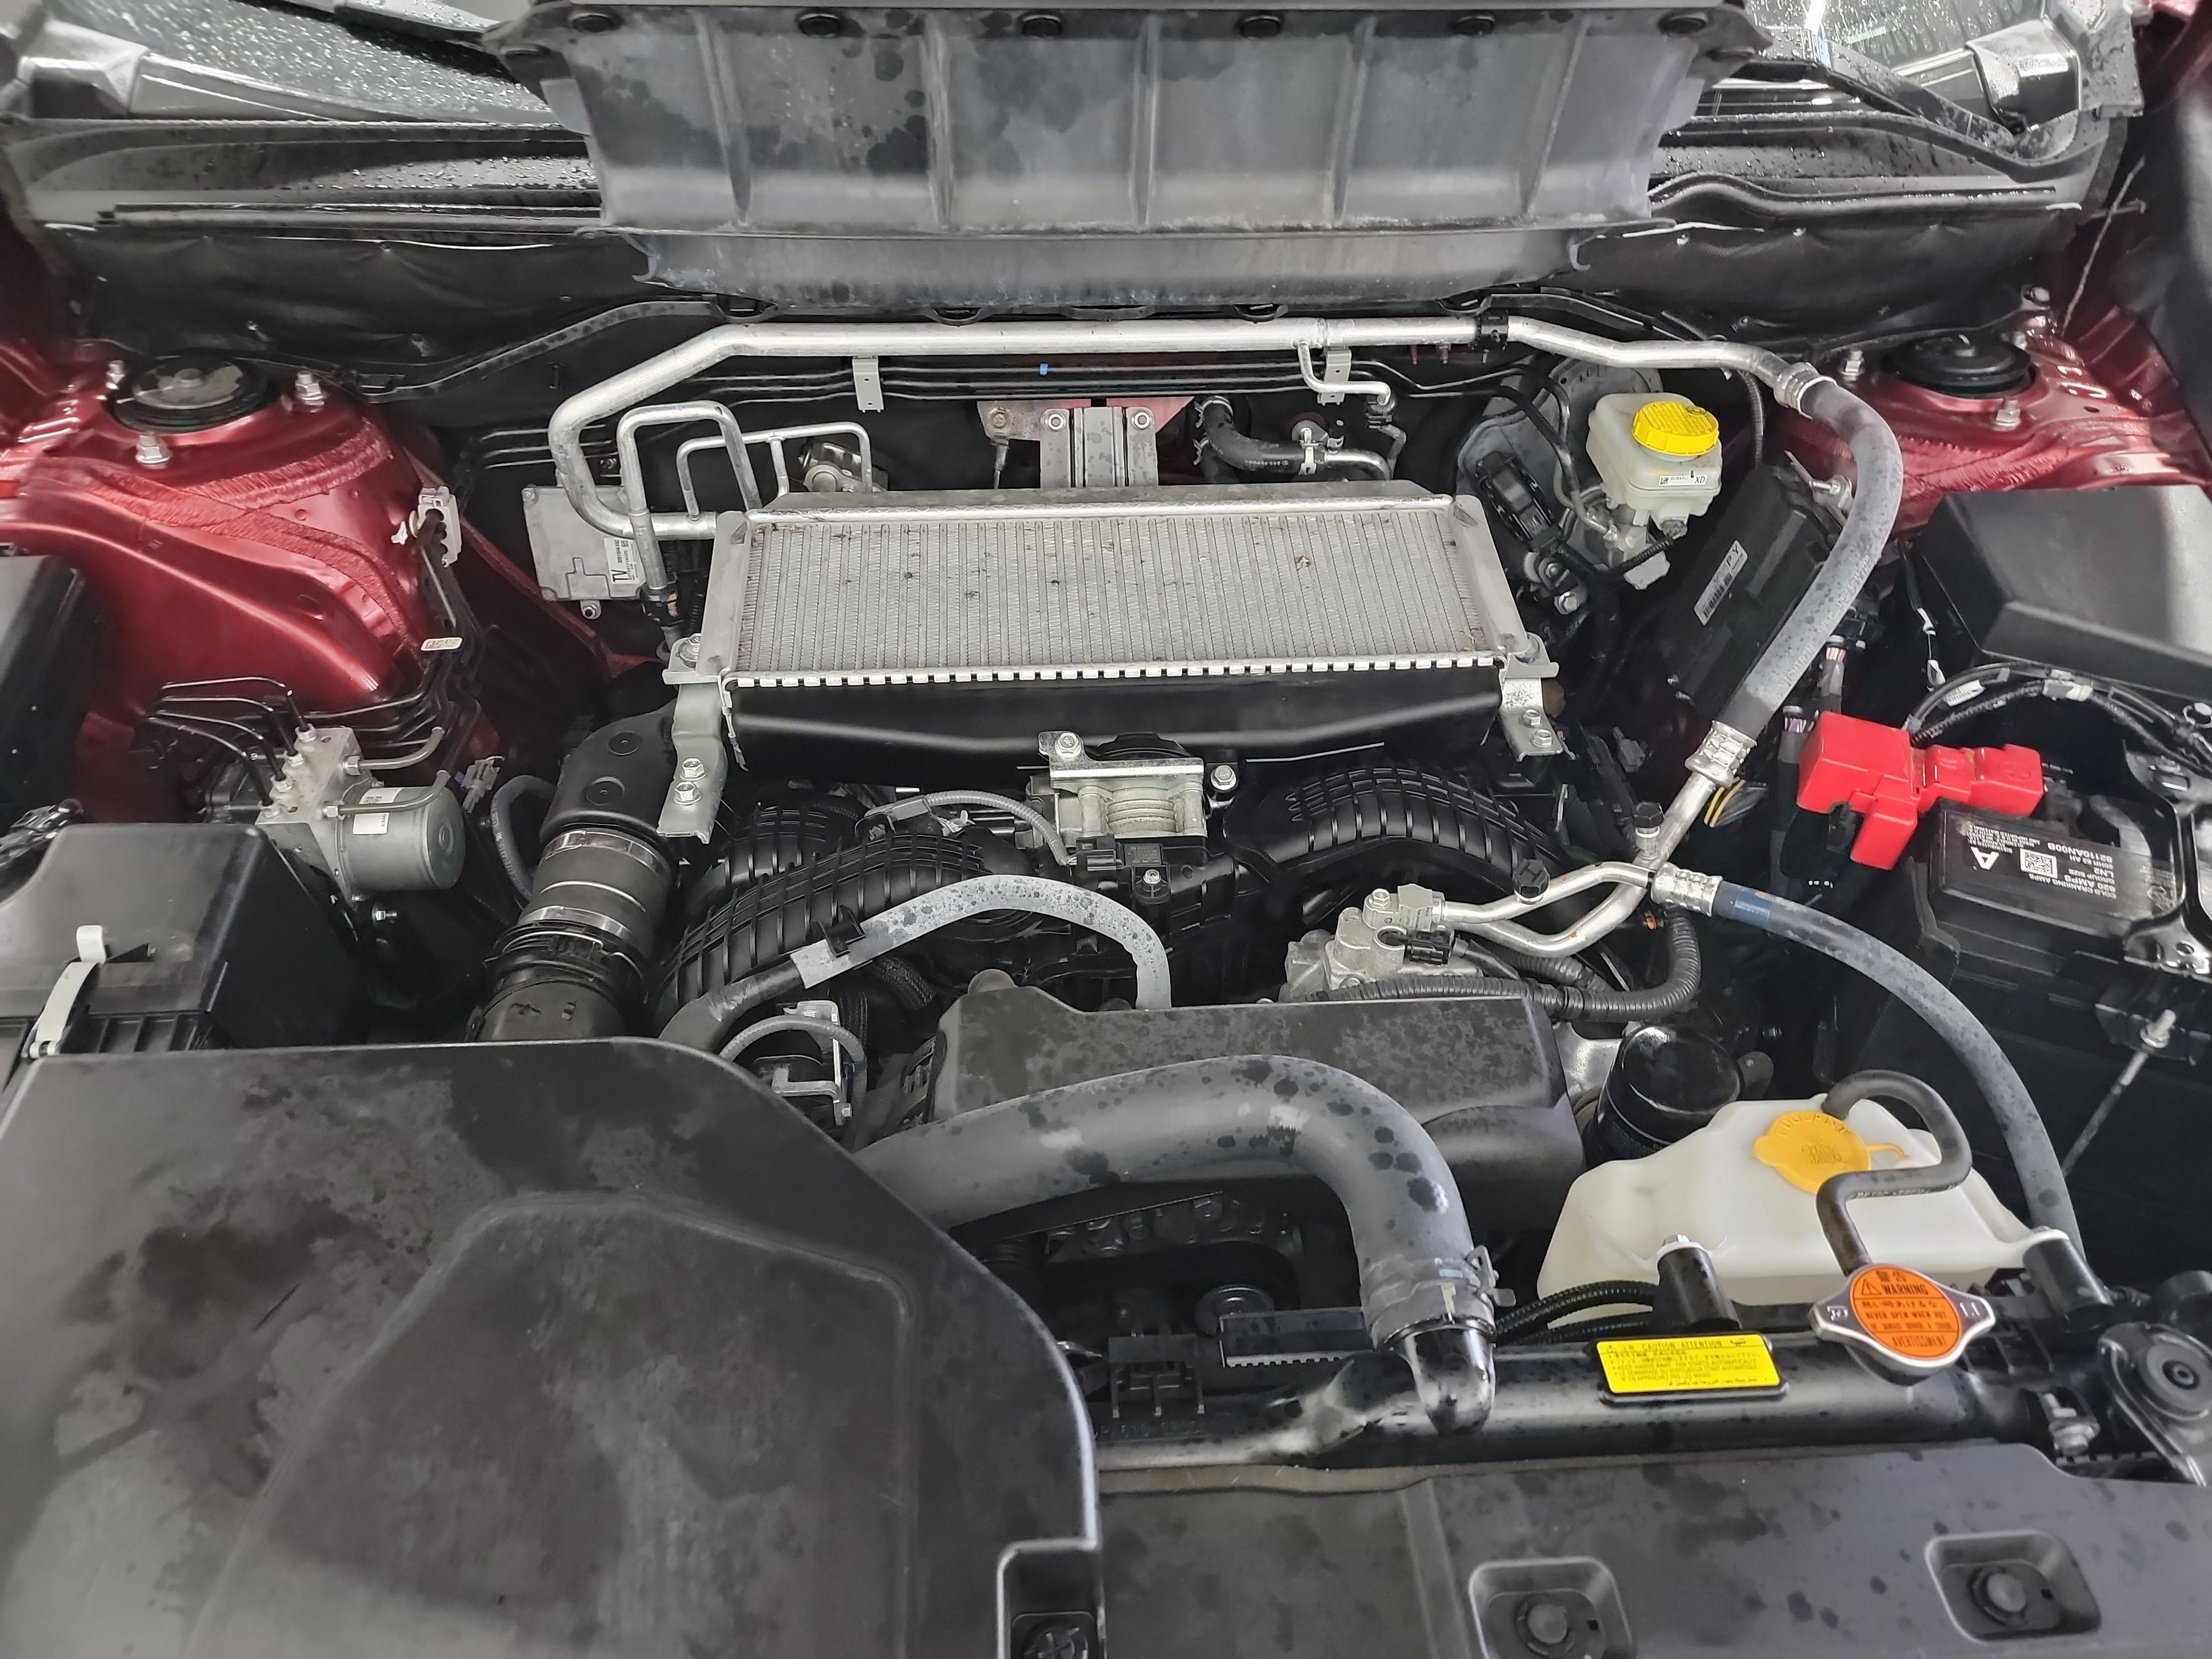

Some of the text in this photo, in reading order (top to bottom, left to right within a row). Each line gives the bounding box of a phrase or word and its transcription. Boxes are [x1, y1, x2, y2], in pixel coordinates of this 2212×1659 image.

[611, 569, 628, 582] TV
[2068, 868, 2115, 885] GROUP SIZE
[2093, 867, 2114, 878] LN2
[2029, 873, 2116, 899] COLD CRANKING AMPS
[2064, 874, 2116, 893] 620 AMPS
[1775, 1113, 1850, 1138] COOLANT
[1881, 1284, 1929, 1295] WARNING
[1865, 1311, 1887, 1320] NEVER
[1891, 1311, 1908, 1319] OPEN
[1912, 1311, 1931, 1319] WHEN
[1642, 1342, 1676, 1351] CAUTION
[1681, 1340, 1723, 1349] ATTENTION
